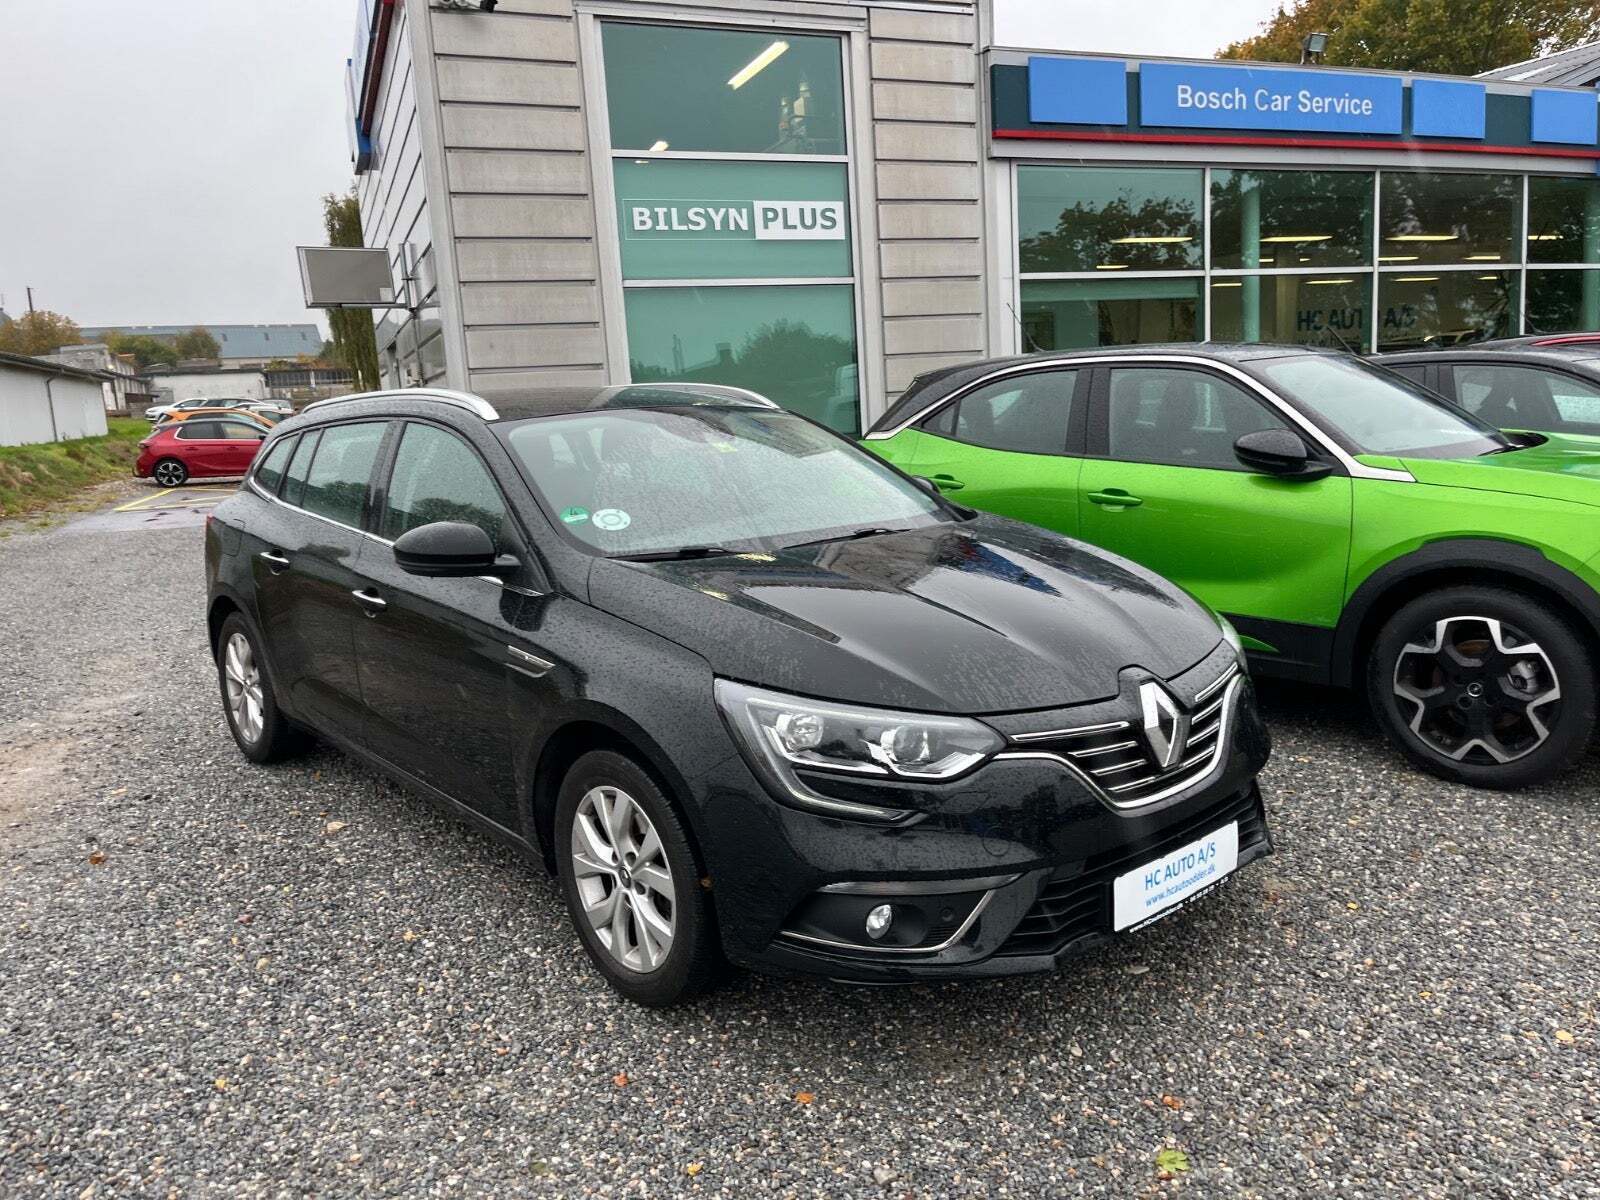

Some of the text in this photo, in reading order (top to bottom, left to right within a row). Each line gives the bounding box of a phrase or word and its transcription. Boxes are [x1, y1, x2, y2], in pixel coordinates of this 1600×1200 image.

[1177, 84, 1373, 115] Bosch Car Service
[632, 207, 837, 231] BILSYN PLUS
[1297, 308, 1323, 331] HC
[1145, 842, 1216, 890] HC AUTO A/S
